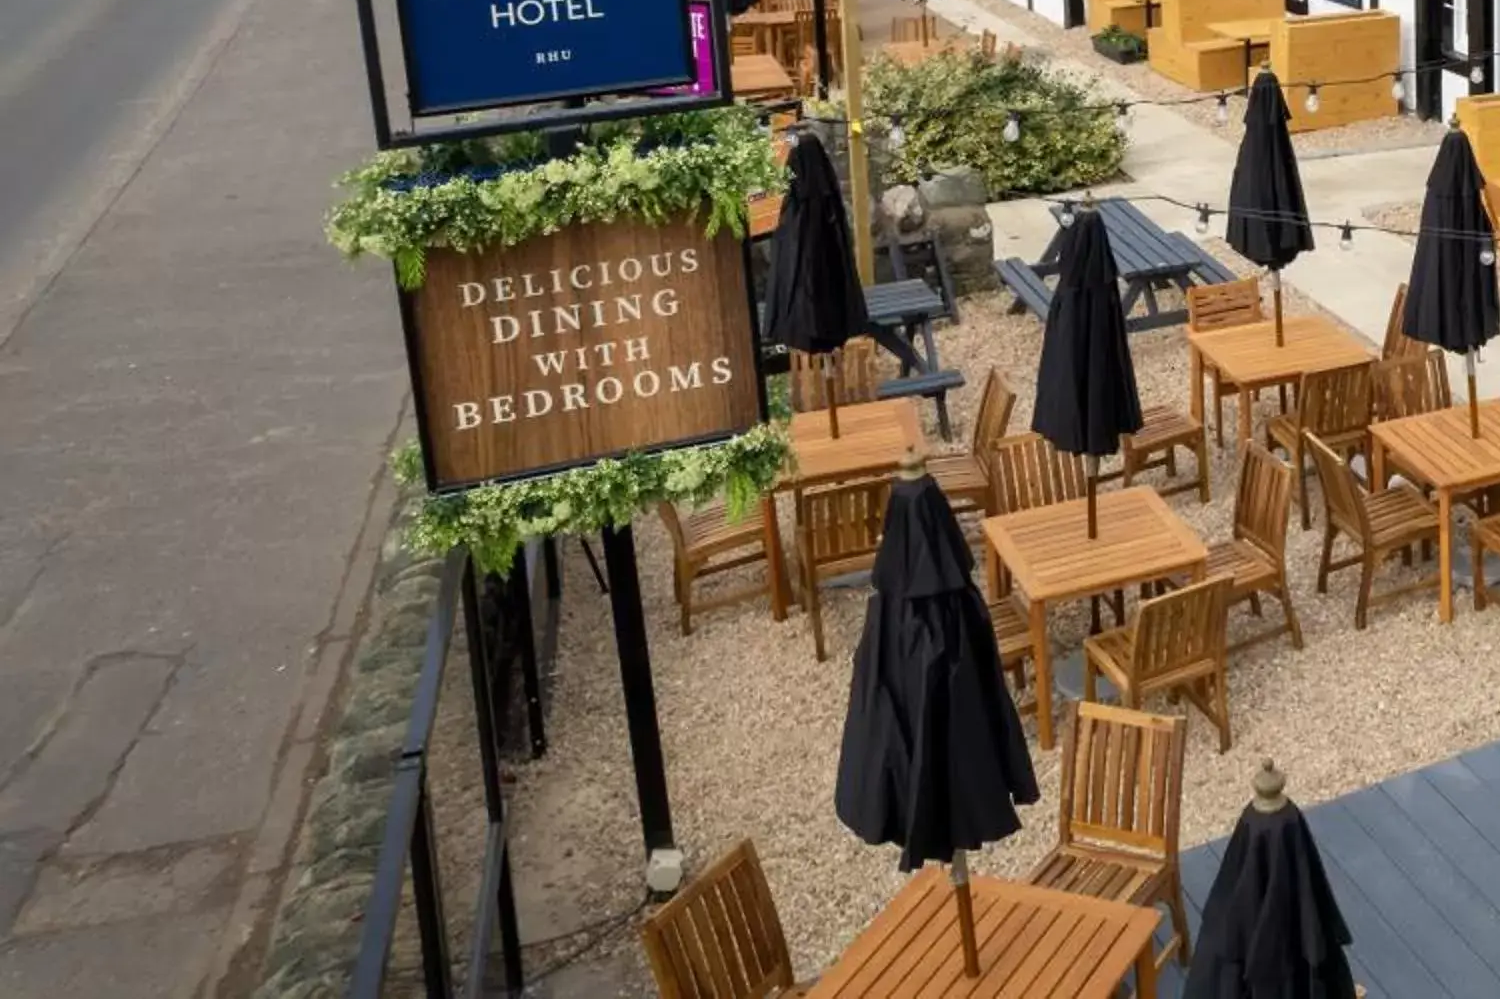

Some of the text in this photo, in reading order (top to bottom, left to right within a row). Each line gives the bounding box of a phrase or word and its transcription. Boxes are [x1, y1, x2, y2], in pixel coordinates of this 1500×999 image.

[536, 49, 571, 65] RHU
[458, 249, 698, 308] DELICIOUS
[490, 289, 679, 344] DINING
[533, 337, 649, 377] WITH
[452, 357, 733, 430] BEDROOMS
